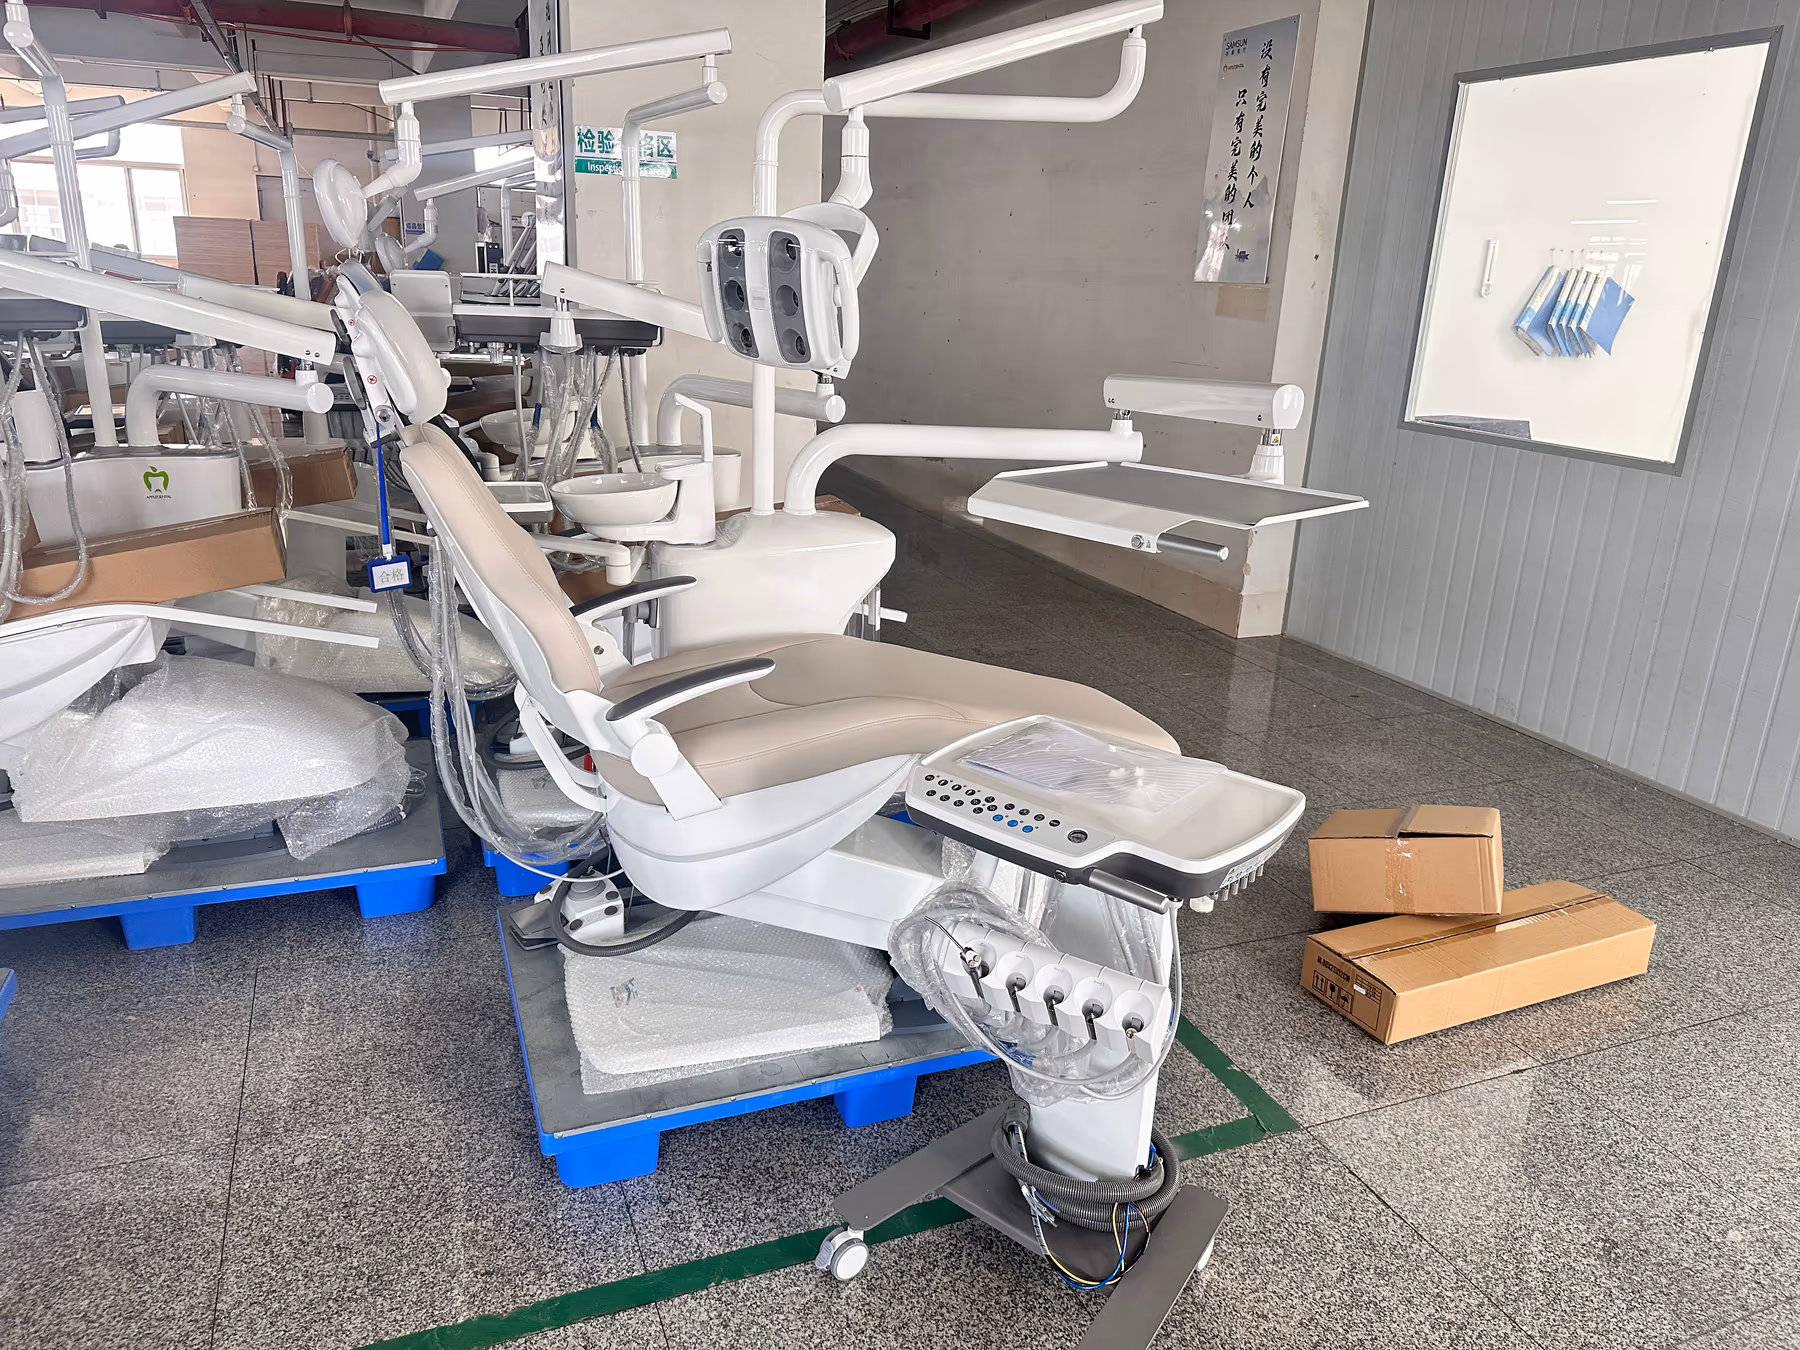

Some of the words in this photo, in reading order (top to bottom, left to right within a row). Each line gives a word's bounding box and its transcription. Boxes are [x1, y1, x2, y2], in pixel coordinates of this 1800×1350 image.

[577, 127, 674, 159] 检验格区
[379, 568, 404, 583] 合格
